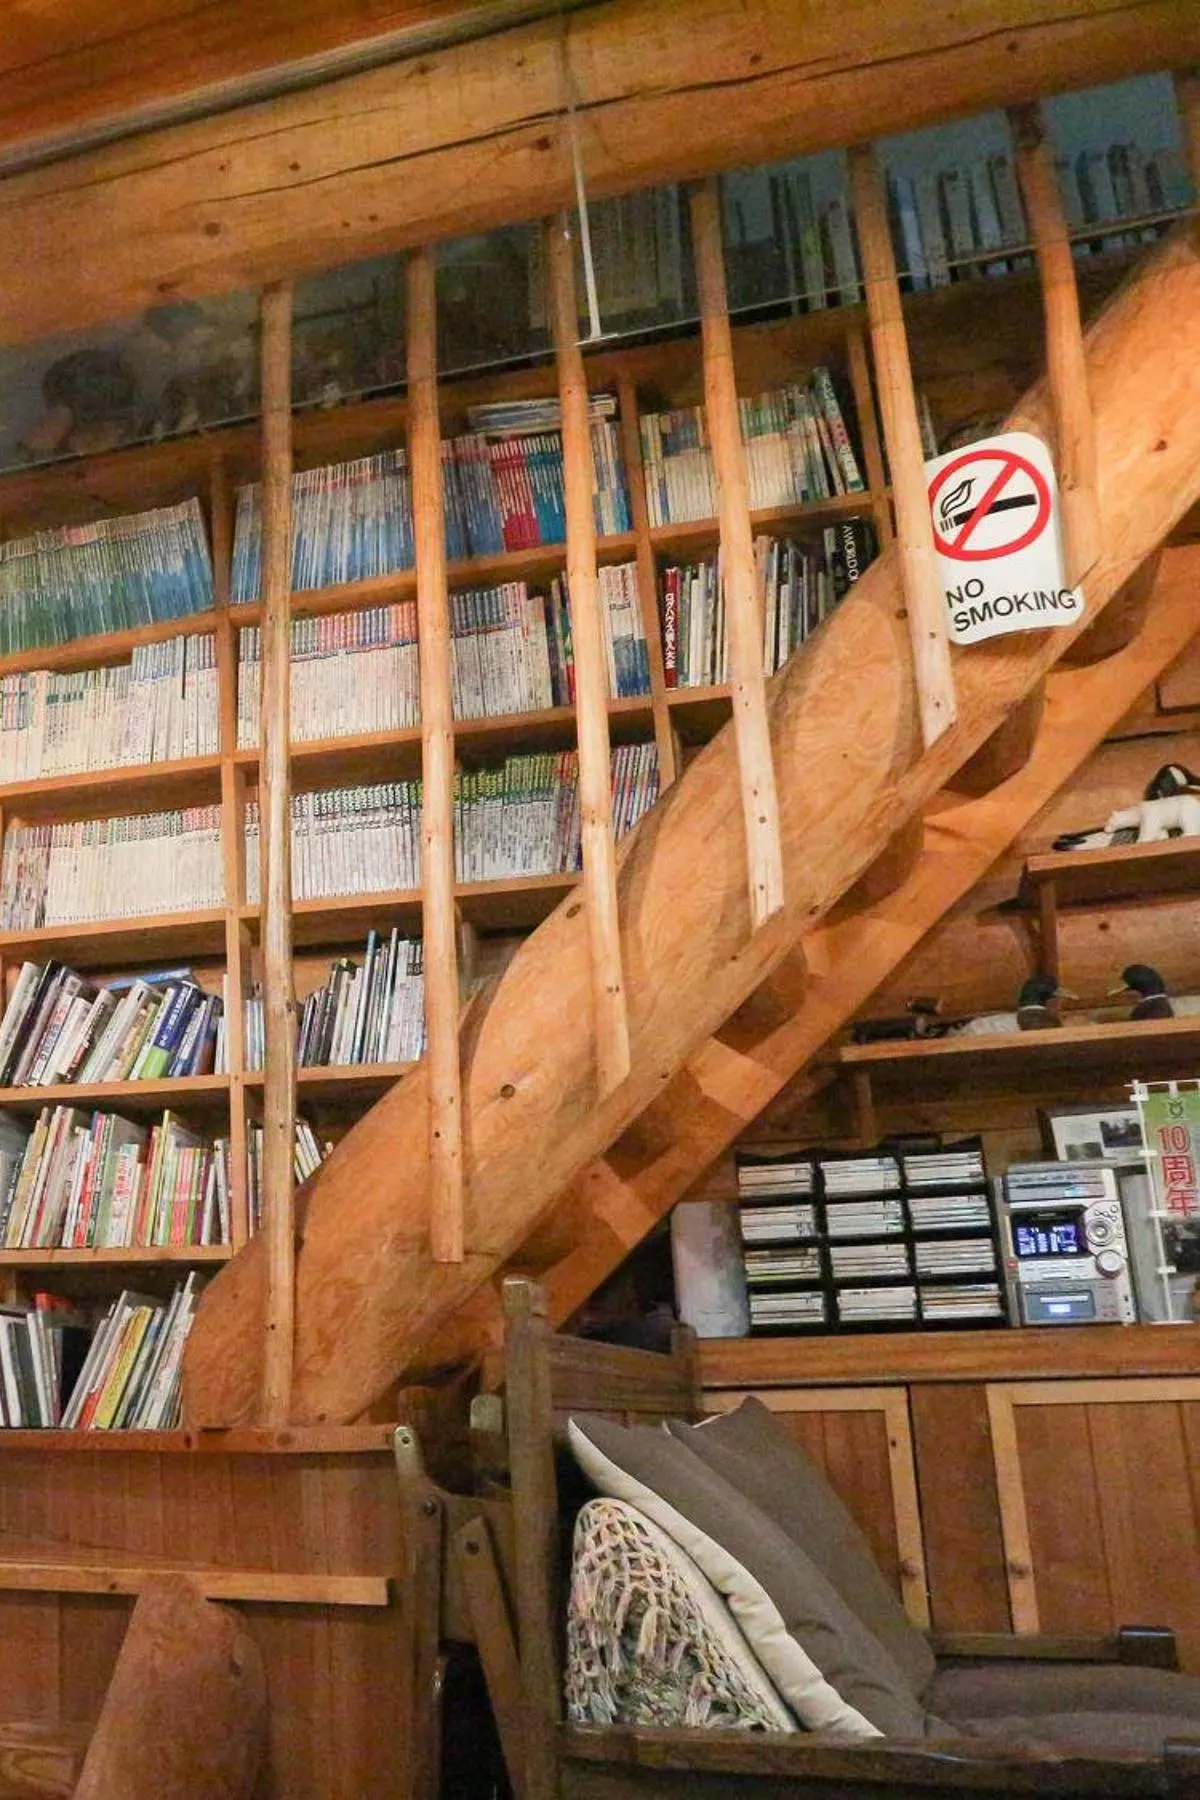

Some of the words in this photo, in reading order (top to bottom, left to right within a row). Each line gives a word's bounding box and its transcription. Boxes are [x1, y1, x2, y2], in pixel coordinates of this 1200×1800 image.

[945, 578, 984, 608] NO
[953, 588, 1077, 632] SMOKING
[1157, 1125, 1199, 1217] 10周年
